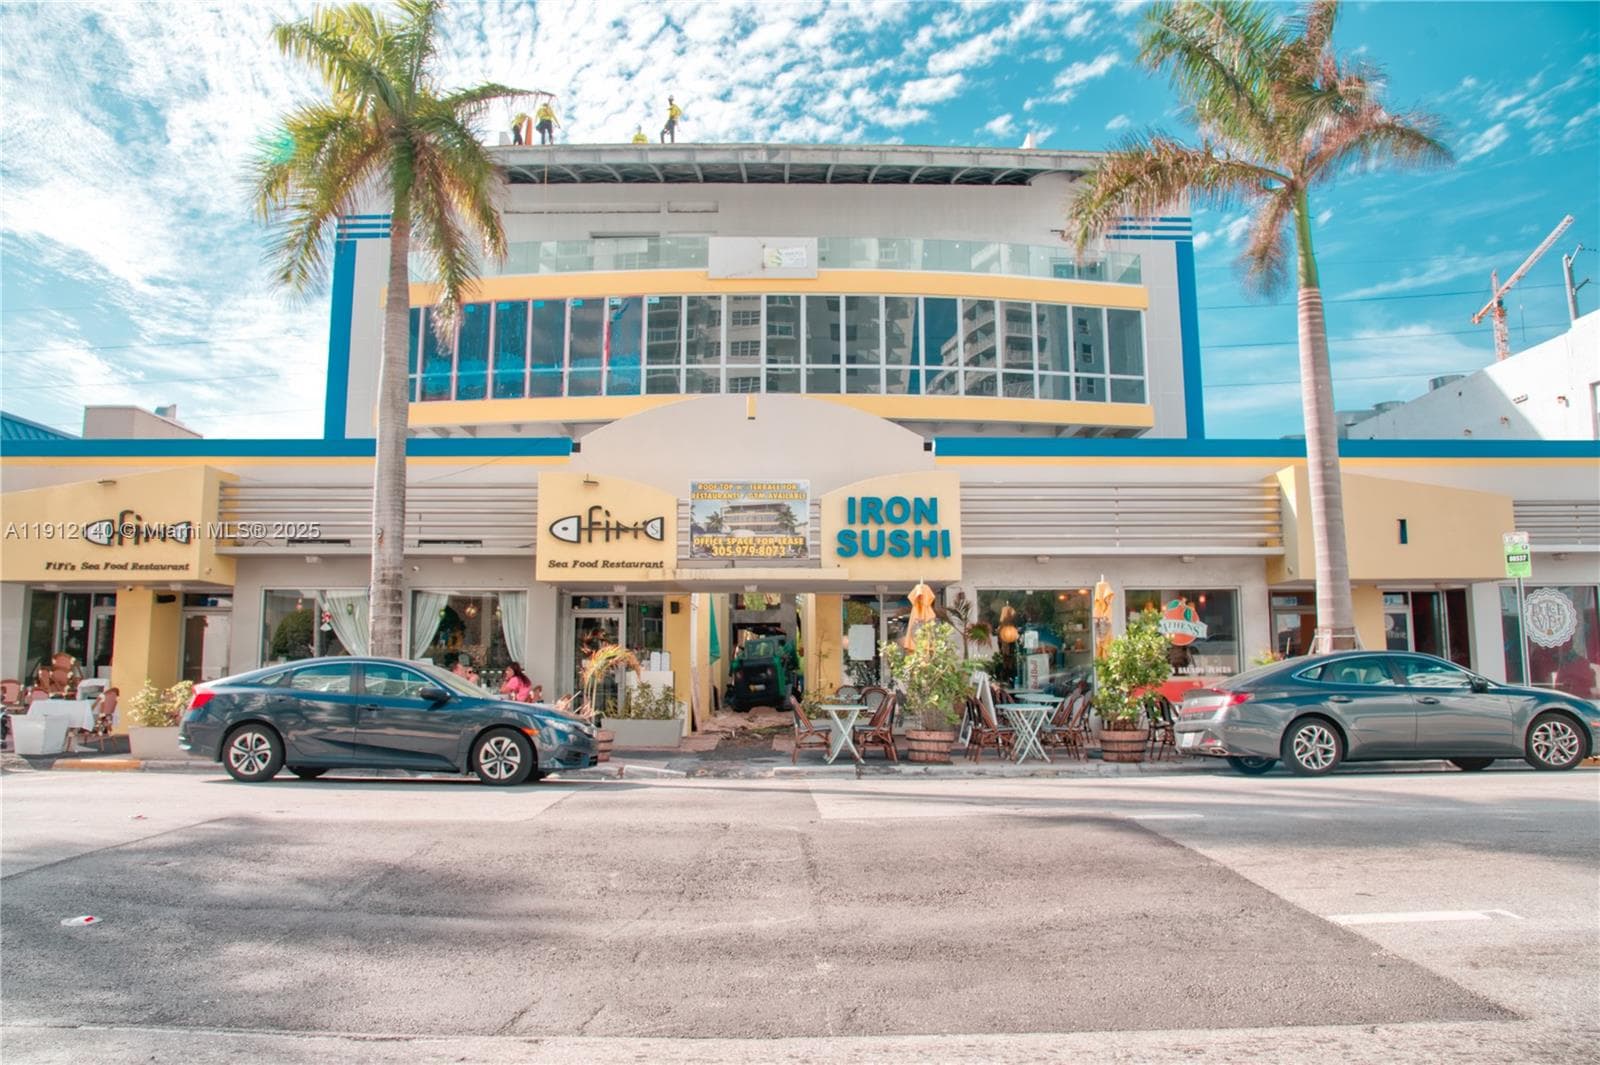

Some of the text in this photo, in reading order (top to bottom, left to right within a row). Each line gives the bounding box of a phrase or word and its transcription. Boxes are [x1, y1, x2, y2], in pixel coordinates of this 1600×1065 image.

[847, 496, 938, 525] IRON
[693, 537, 804, 545] OFFICE SPACE FOR LEASE
[836, 529, 951, 558] SUSHI
[81, 562, 100, 571] Sea
[103, 562, 128, 571] Food
[131, 562, 189, 571] Restaurant
[548, 560, 664, 569] Sea Food Restaurant
